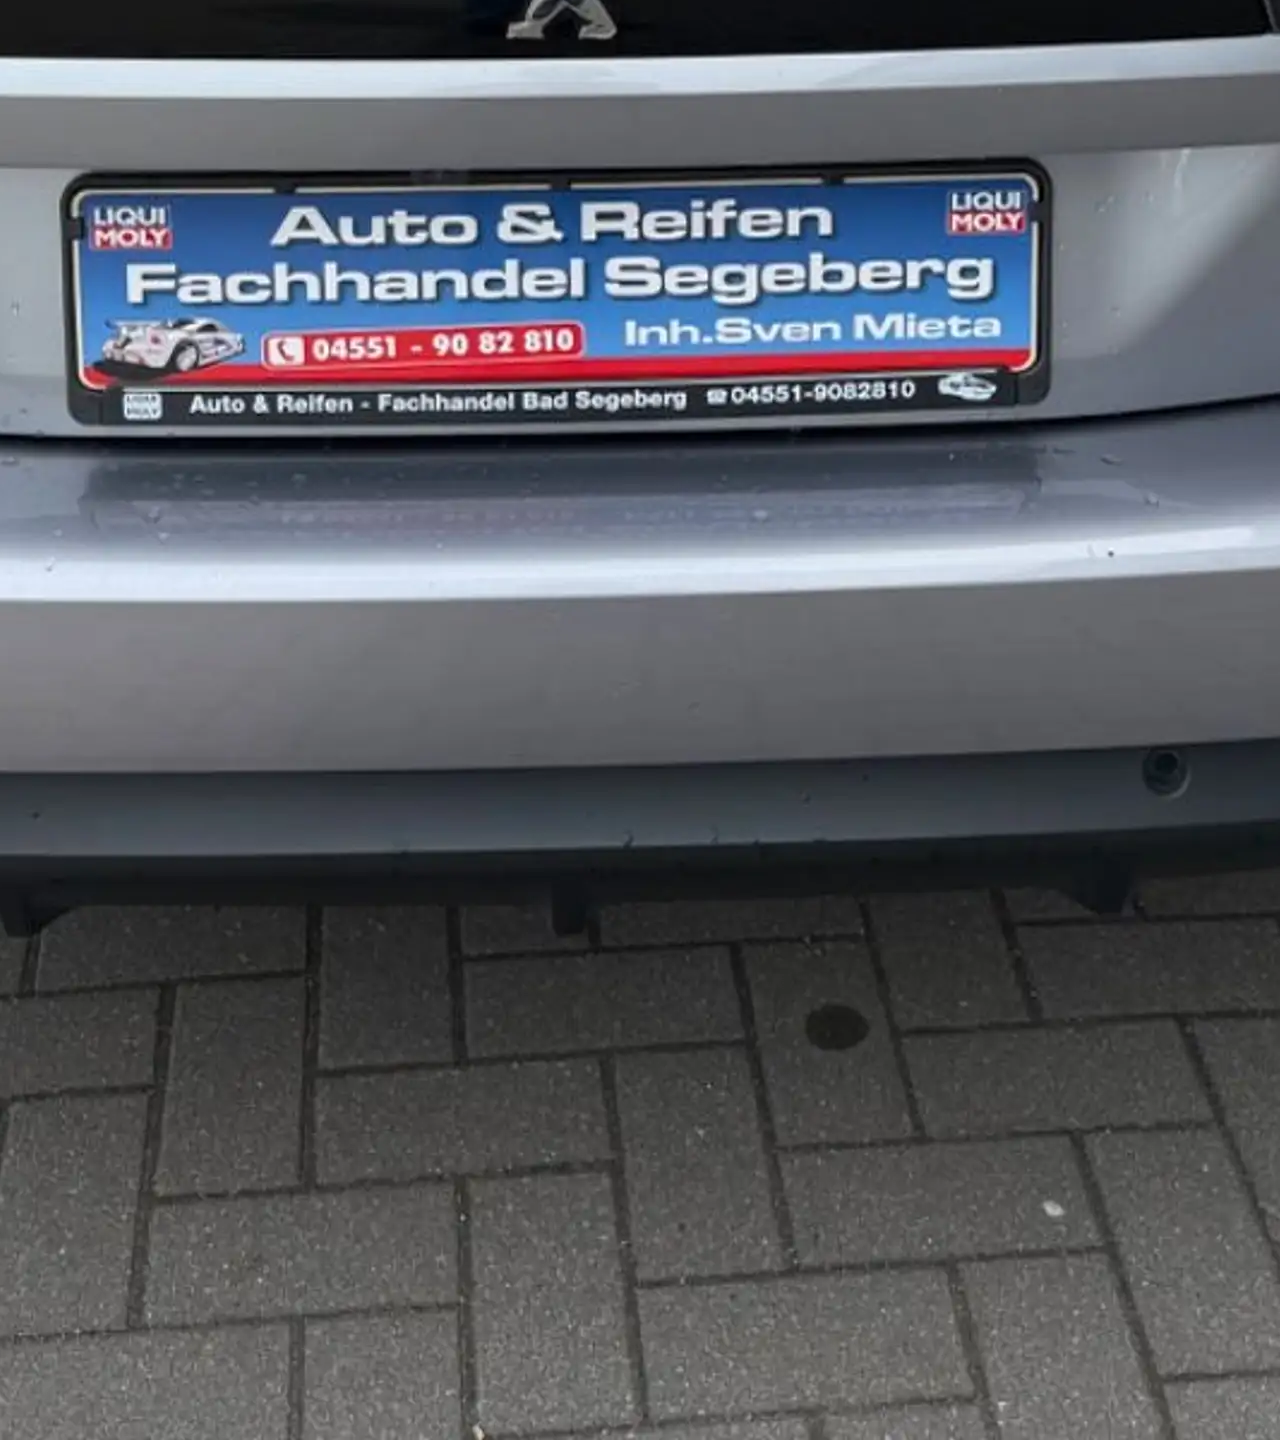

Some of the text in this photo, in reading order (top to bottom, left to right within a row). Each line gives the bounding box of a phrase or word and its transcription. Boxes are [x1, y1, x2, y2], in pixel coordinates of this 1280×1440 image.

[951, 191, 1021, 212] LIQUI
[93, 205, 167, 228] LIQUI
[270, 198, 833, 247] Auto & Reifen
[950, 212, 1024, 233] MOLY
[94, 229, 169, 248] MOLY
[125, 252, 995, 303] Fachhandel Segeberg
[853, 311, 1003, 341] Mieta
[312, 335, 398, 362] 04551
[432, 331, 468, 358] 90
[478, 329, 515, 356] 82
[523, 326, 574, 354] 810
[189, 393, 246, 415] Auto
[253, 393, 269, 414] &
[276, 392, 354, 414] Reifen
[377, 390, 515, 413] Fachhandel
[523, 389, 567, 411] Bad
[575, 388, 687, 412] Segeberg
